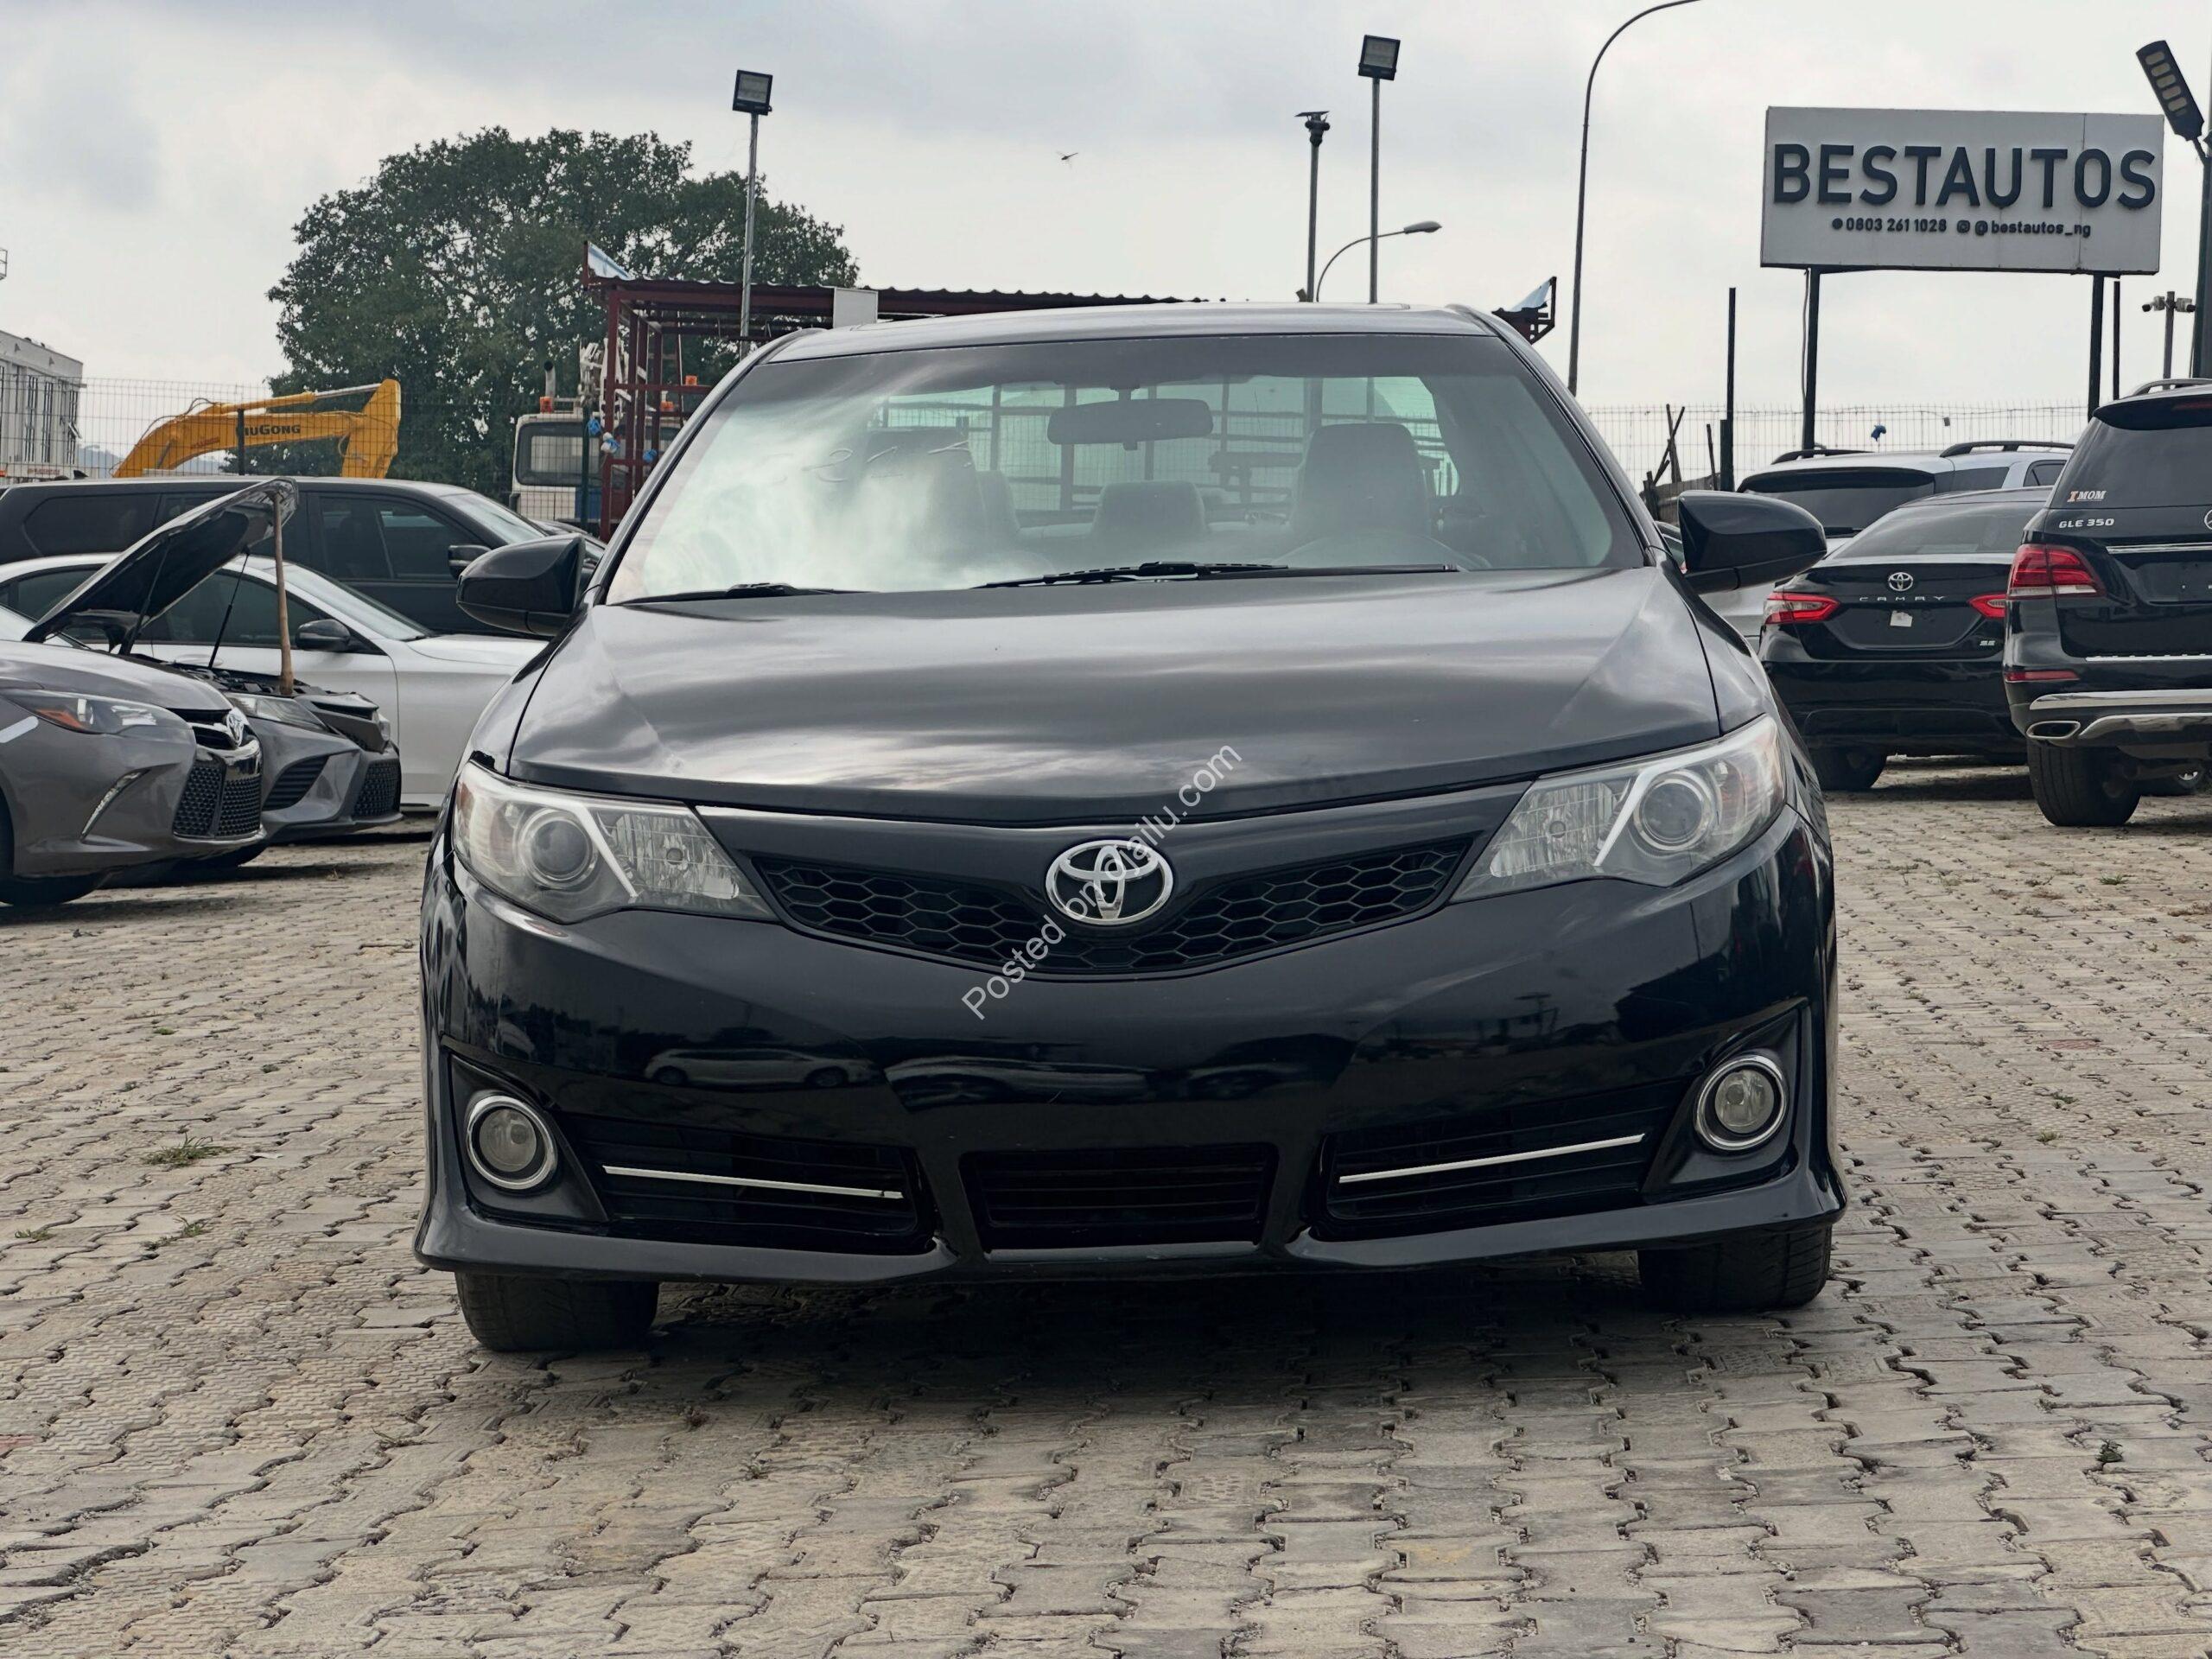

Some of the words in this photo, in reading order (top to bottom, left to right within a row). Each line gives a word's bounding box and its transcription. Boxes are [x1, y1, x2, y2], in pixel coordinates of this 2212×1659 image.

[1773, 143, 2156, 210] BESTAUTOS
[1846, 218, 1883, 232] 0803
[1887, 219, 1910, 232] 261
[1914, 219, 1947, 233] 1028
[1974, 219, 2091, 238] @bestautos_ng
[2077, 490, 2107, 501] MOM
[2058, 520, 2084, 529] GLE
[2087, 518, 2115, 527] 350
